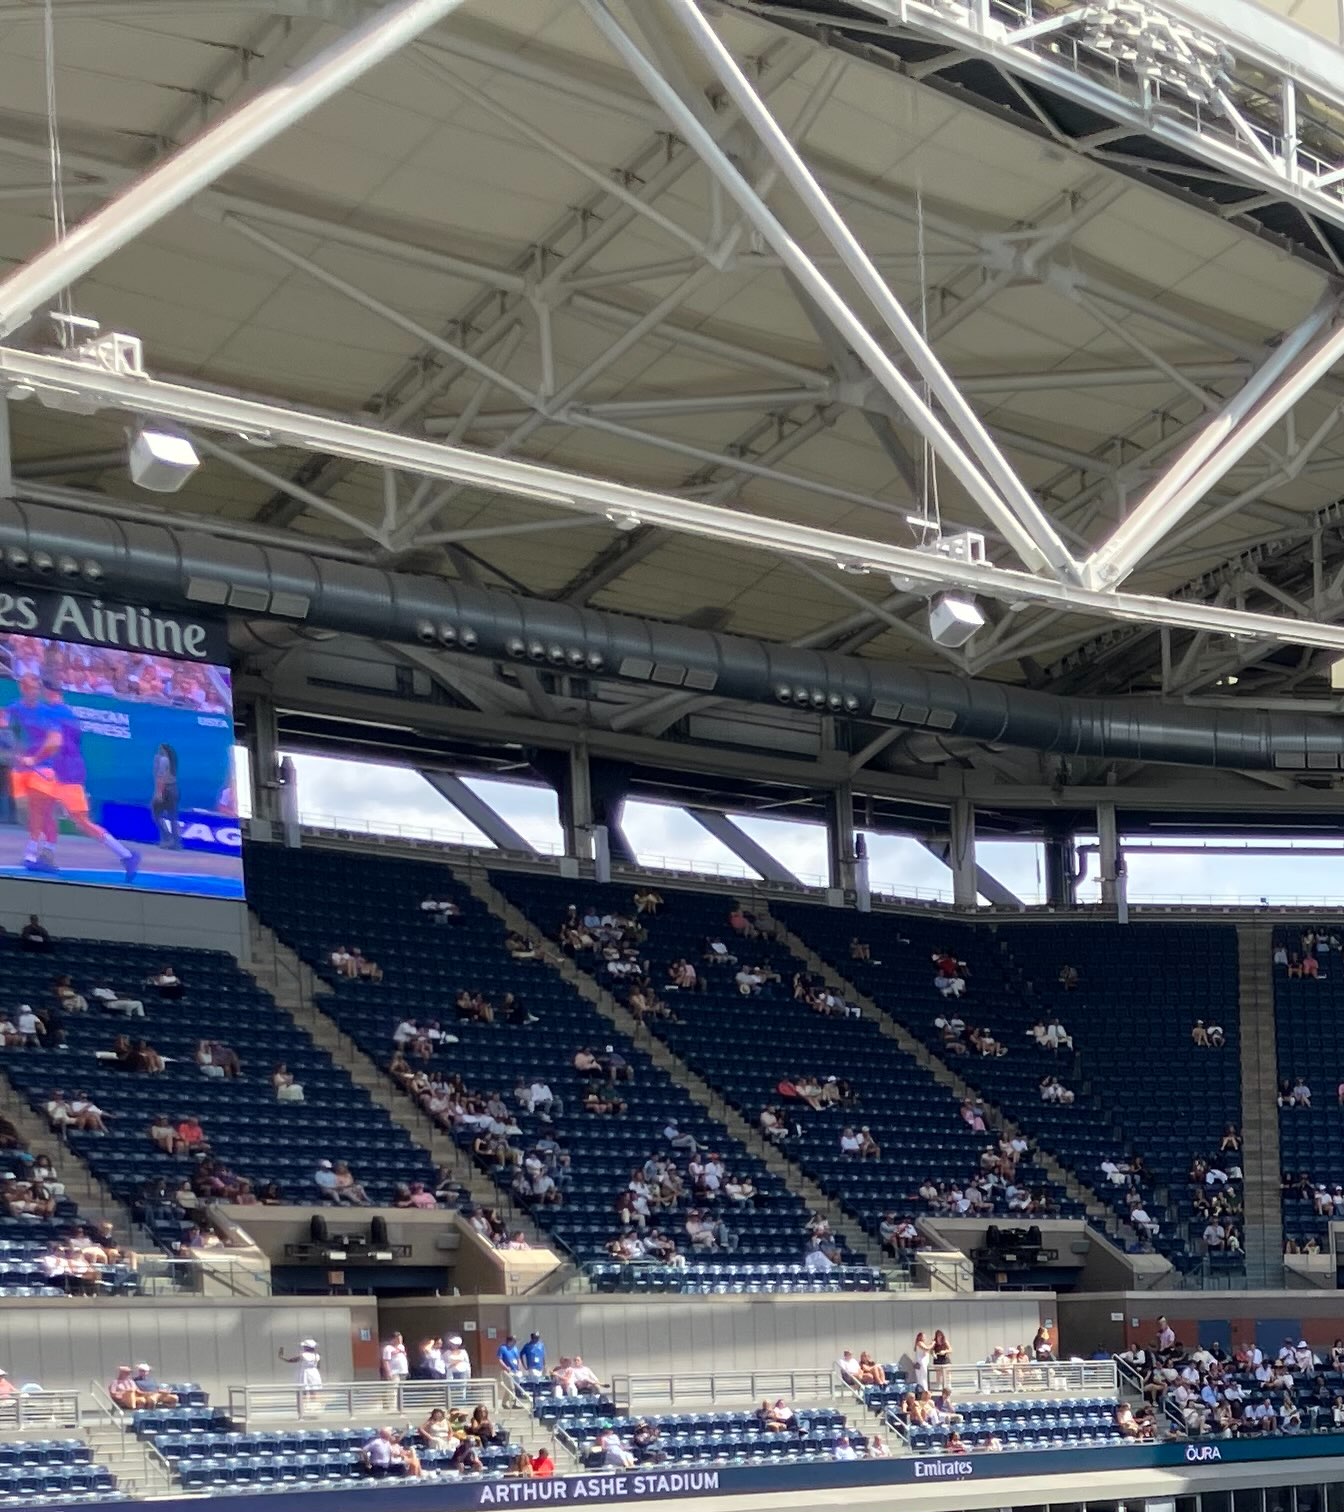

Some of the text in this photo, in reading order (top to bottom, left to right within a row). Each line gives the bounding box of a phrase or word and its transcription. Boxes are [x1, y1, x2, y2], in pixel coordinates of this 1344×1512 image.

[52, 594, 207, 657] Airline
[915, 1460, 973, 1477] Emirates
[481, 1472, 719, 1504] ARTHUR ASHE STADIUM
